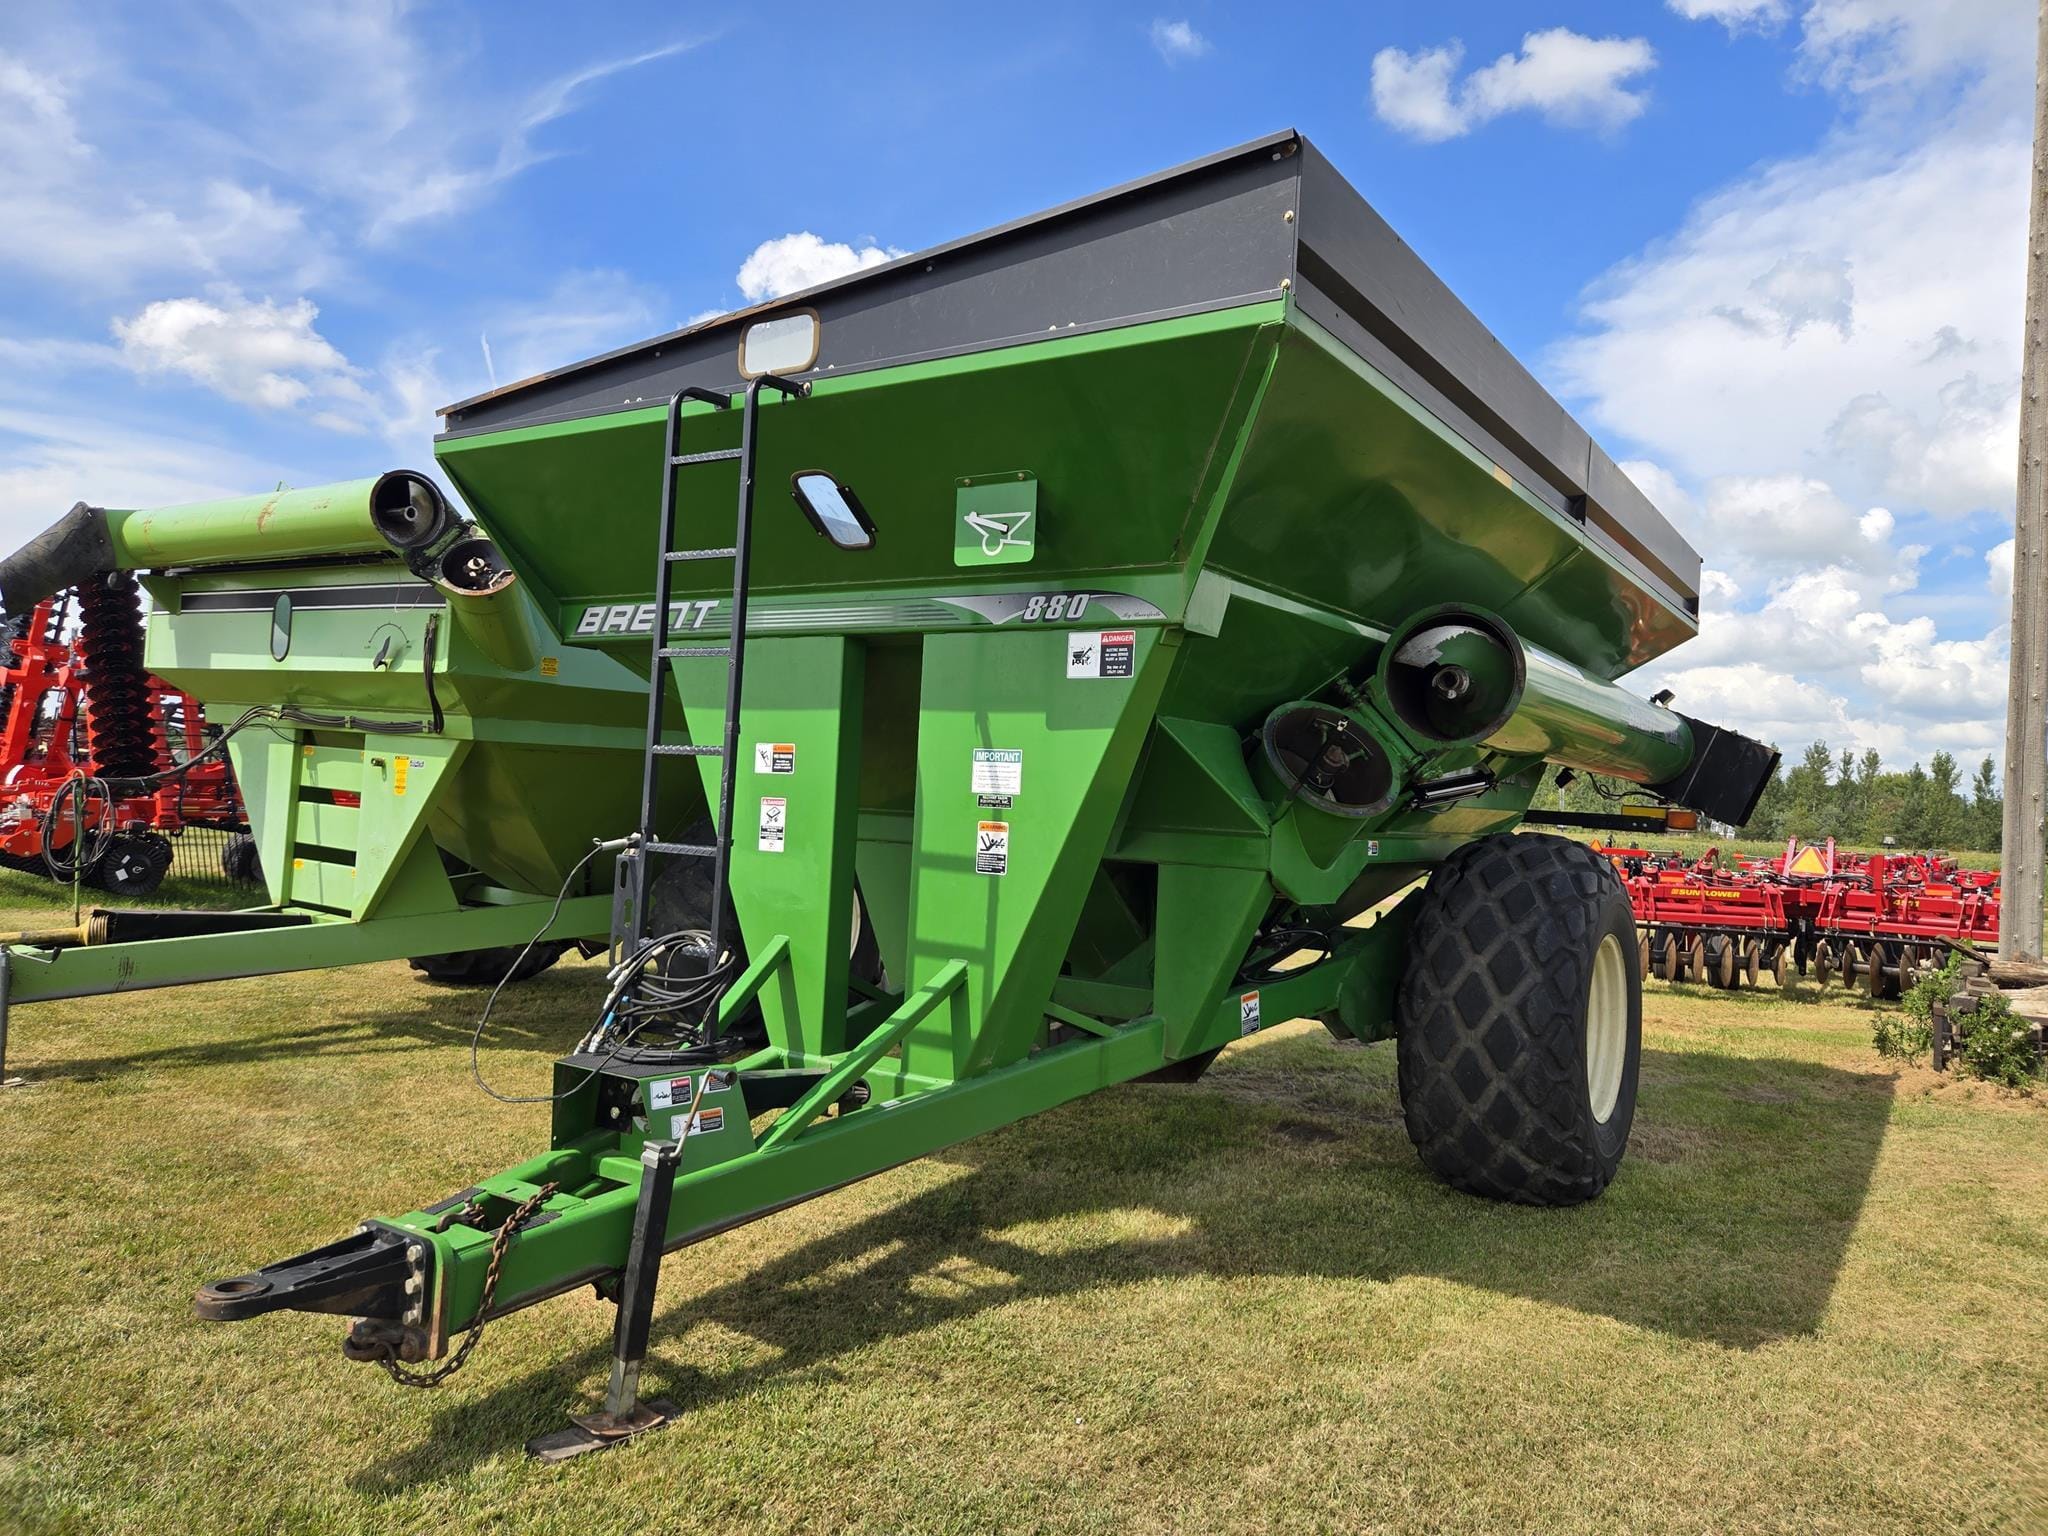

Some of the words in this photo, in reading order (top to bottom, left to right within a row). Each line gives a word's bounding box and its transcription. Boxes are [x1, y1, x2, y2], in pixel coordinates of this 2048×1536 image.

[1022, 594, 1090, 622] 880
[576, 600, 720, 635] BRENT
[1109, 634, 1134, 642] DANGER
[976, 751, 1020, 762] IMPORTANT
[1679, 888, 1740, 898] SUNLOWER
